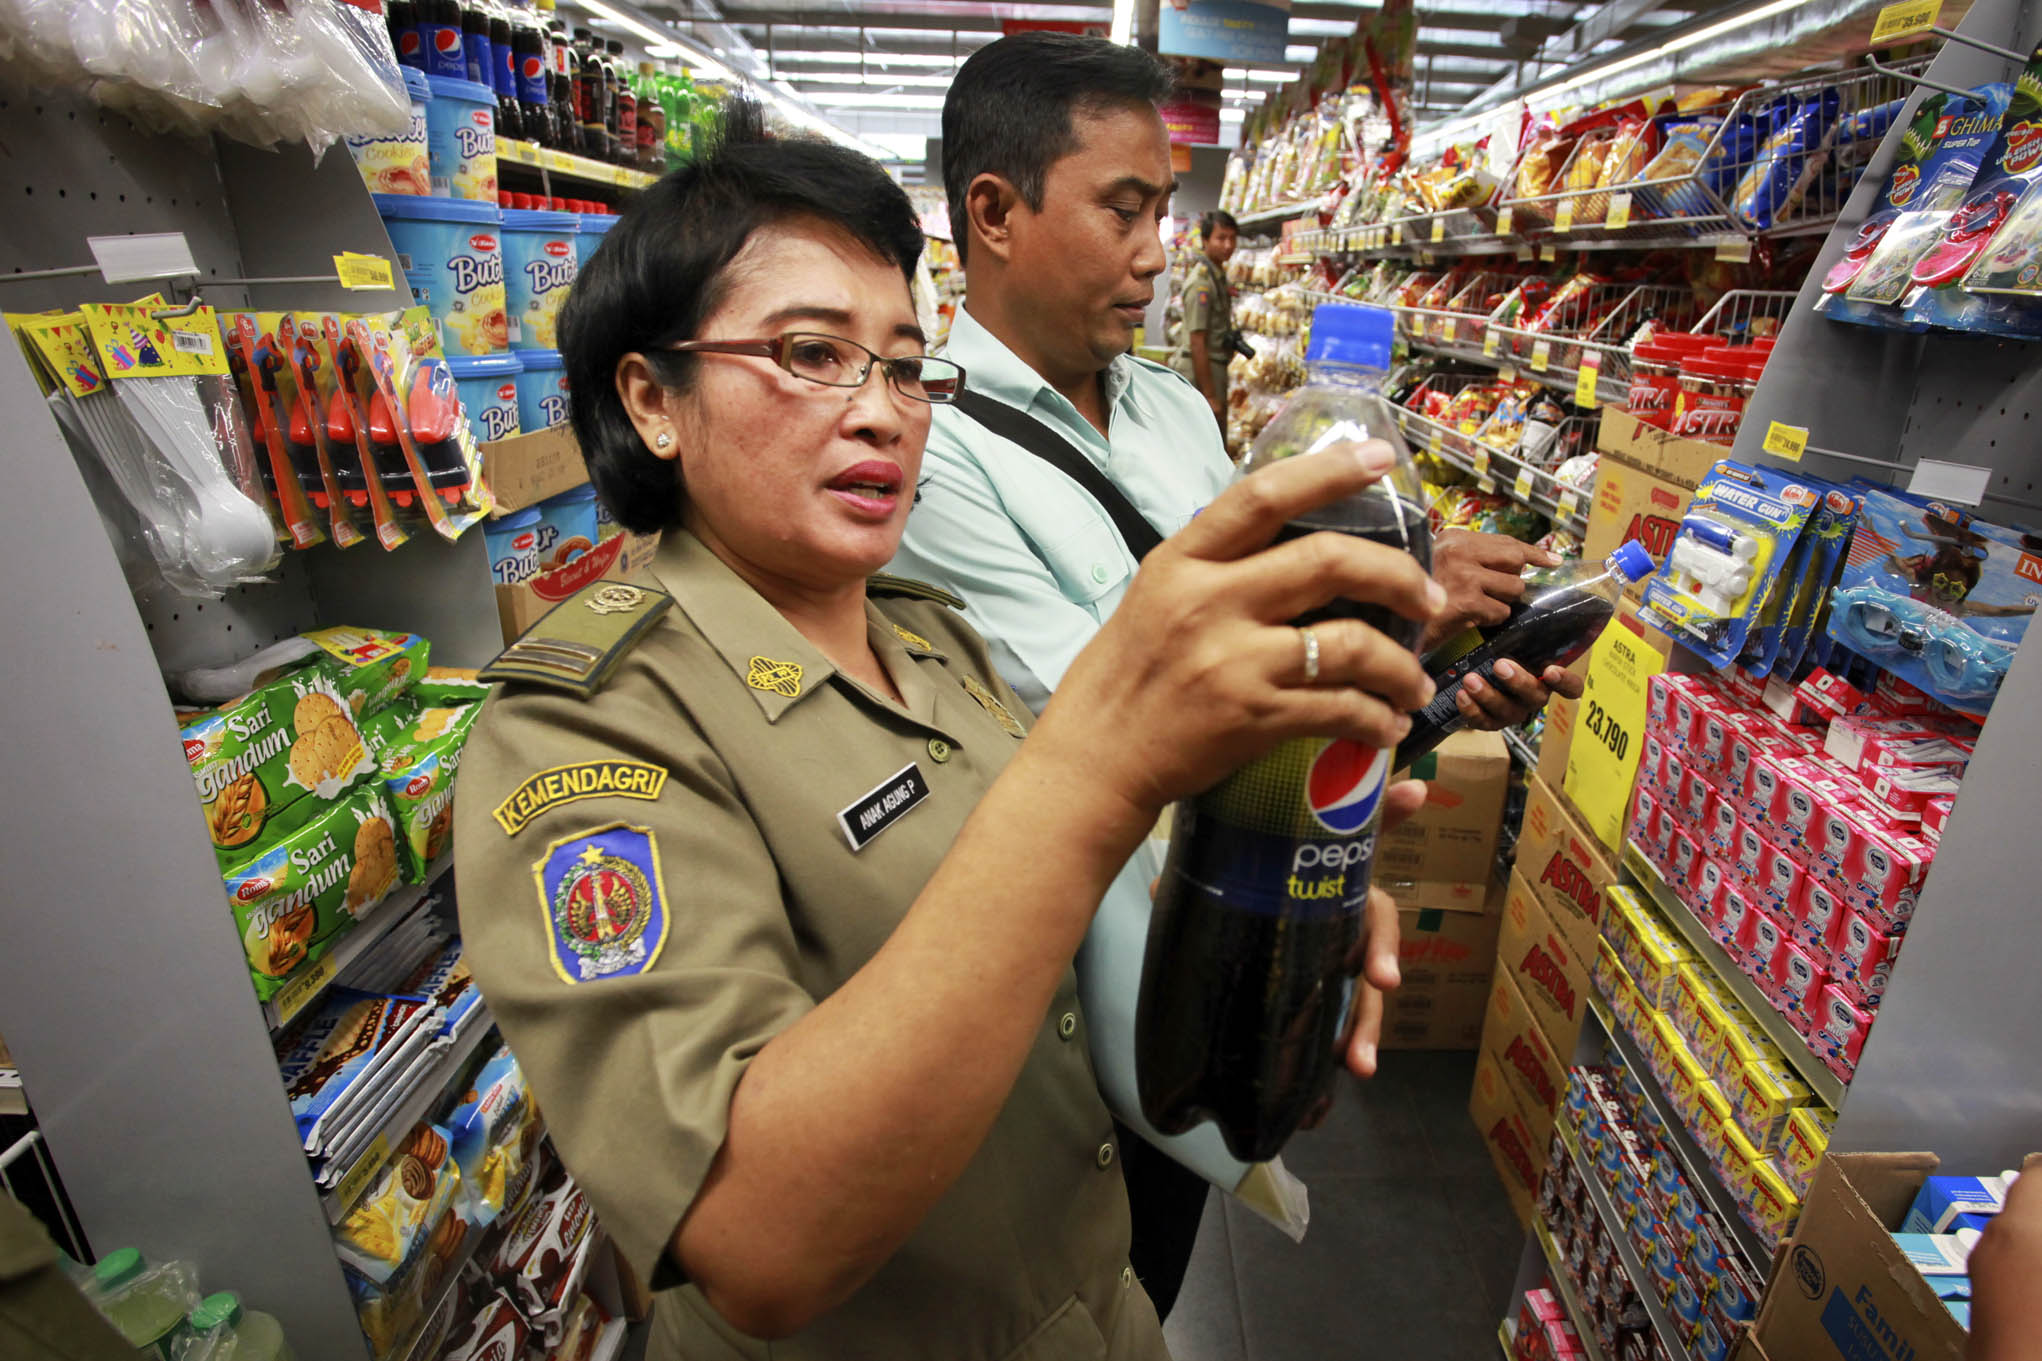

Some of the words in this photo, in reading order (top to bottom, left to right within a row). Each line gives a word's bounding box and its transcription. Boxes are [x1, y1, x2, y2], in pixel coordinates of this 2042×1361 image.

[1714, 483, 1760, 510] WATER
[1757, 501, 1782, 519] GUN
[1613, 640, 1636, 665] ASTRA
[227, 702, 273, 742] Sari
[1585, 700, 1629, 762] 23.790
[199, 727, 292, 803] gandum
[502, 764, 659, 828] KEMENDAGRI
[860, 802, 885, 830] ANAK
[882, 784, 910, 813] AGUNG
[906, 779, 916, 795] P
[290, 830, 337, 876] Sari
[1292, 842, 1375, 872] peps
[241, 877, 271, 899] Roma
[251, 852, 351, 940] gandum
[1288, 874, 1346, 899] twist
[1541, 851, 1601, 925] ASTRA
[1519, 944, 1576, 1022] ASTRA
[1504, 1034, 1557, 1114] ASTRA
